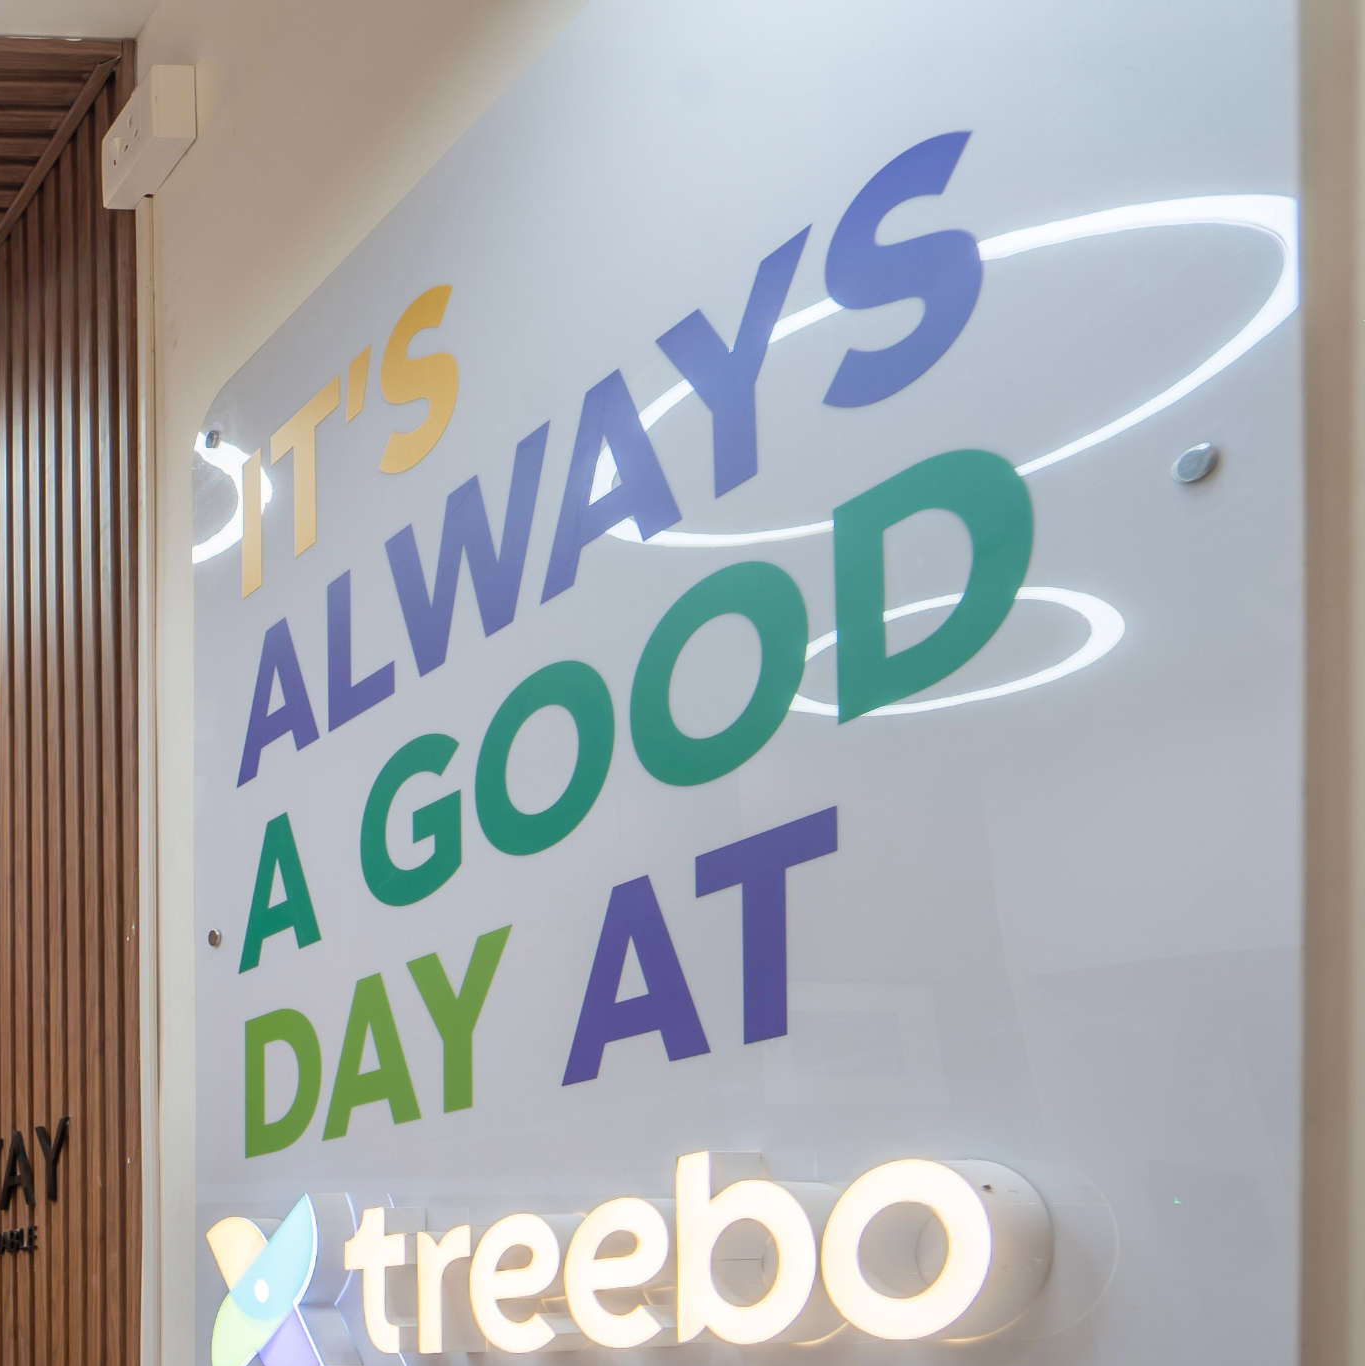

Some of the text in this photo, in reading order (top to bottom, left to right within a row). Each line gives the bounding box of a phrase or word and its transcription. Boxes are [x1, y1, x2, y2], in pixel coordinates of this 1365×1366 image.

[237, 130, 986, 789] ALWAYS
[240, 283, 460, 600] IT'S
[238, 448, 1037, 974] A GOOD
[243, 805, 839, 1160] DAY AT
[345, 1149, 994, 1354] treebo
